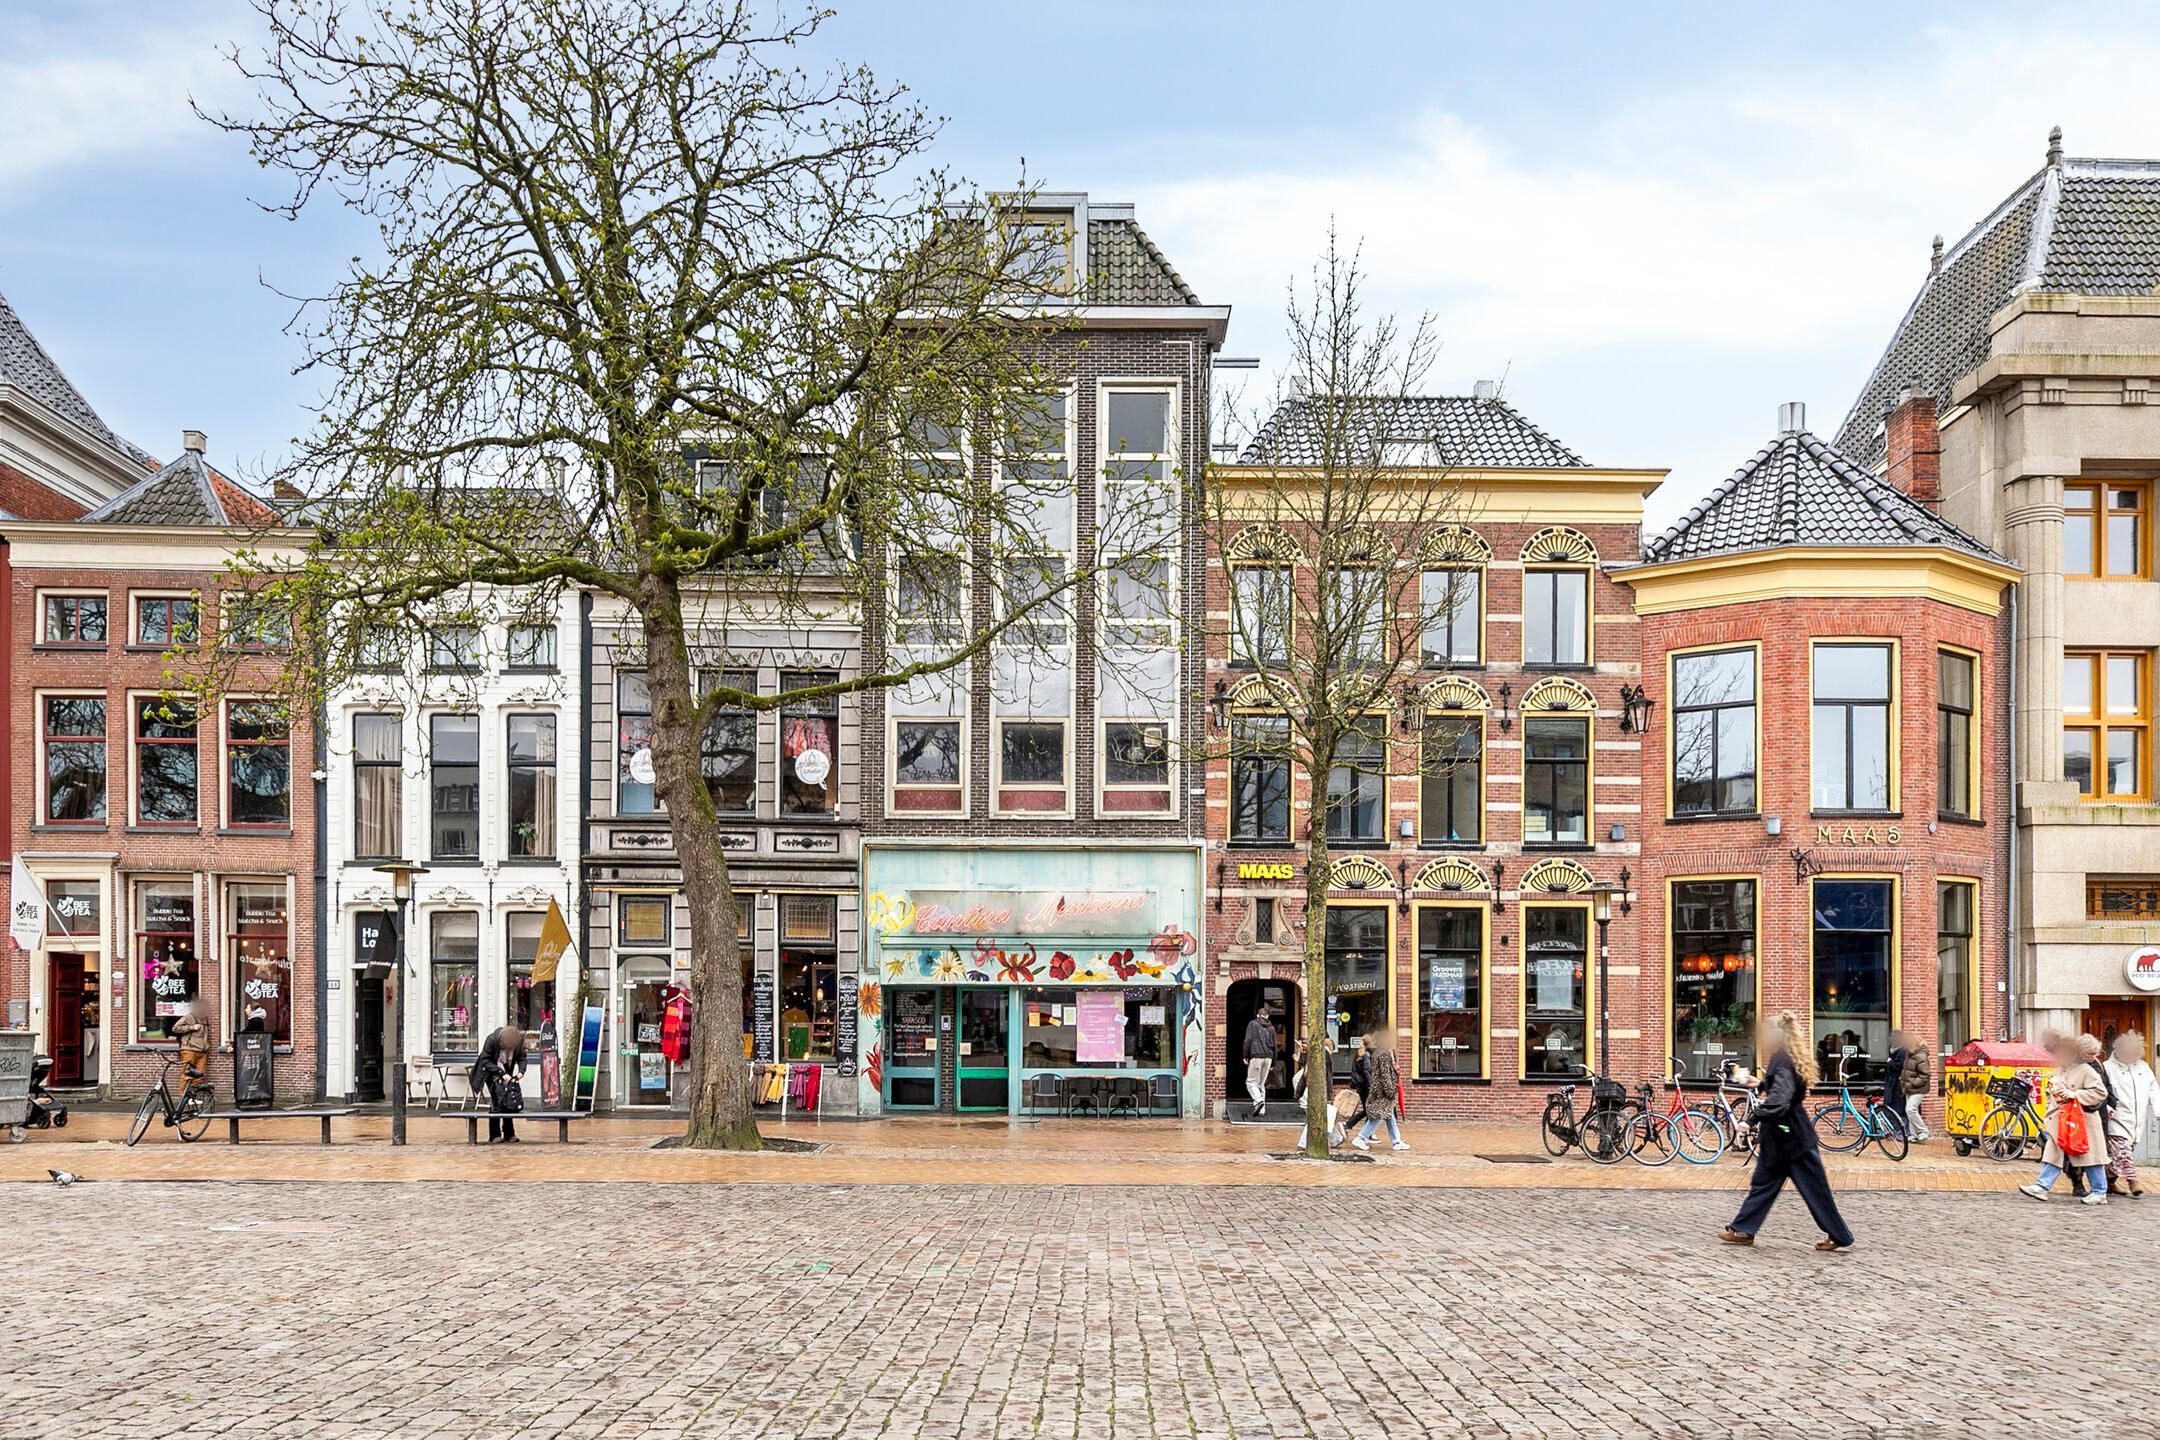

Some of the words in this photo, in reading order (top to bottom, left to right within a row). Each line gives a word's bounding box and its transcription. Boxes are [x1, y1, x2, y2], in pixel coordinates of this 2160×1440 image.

[1815, 825, 1901, 844] MAAS
[1238, 863, 1294, 879] MAAS
[73, 908, 91, 916] TEA
[915, 903, 1011, 932] Cantina
[1026, 891, 1145, 927] Mexicana
[362, 928, 379, 937] Ha
[362, 939, 376, 947] Lo
[1432, 965, 1463, 973] Groovers
[261, 990, 279, 998] TEA
